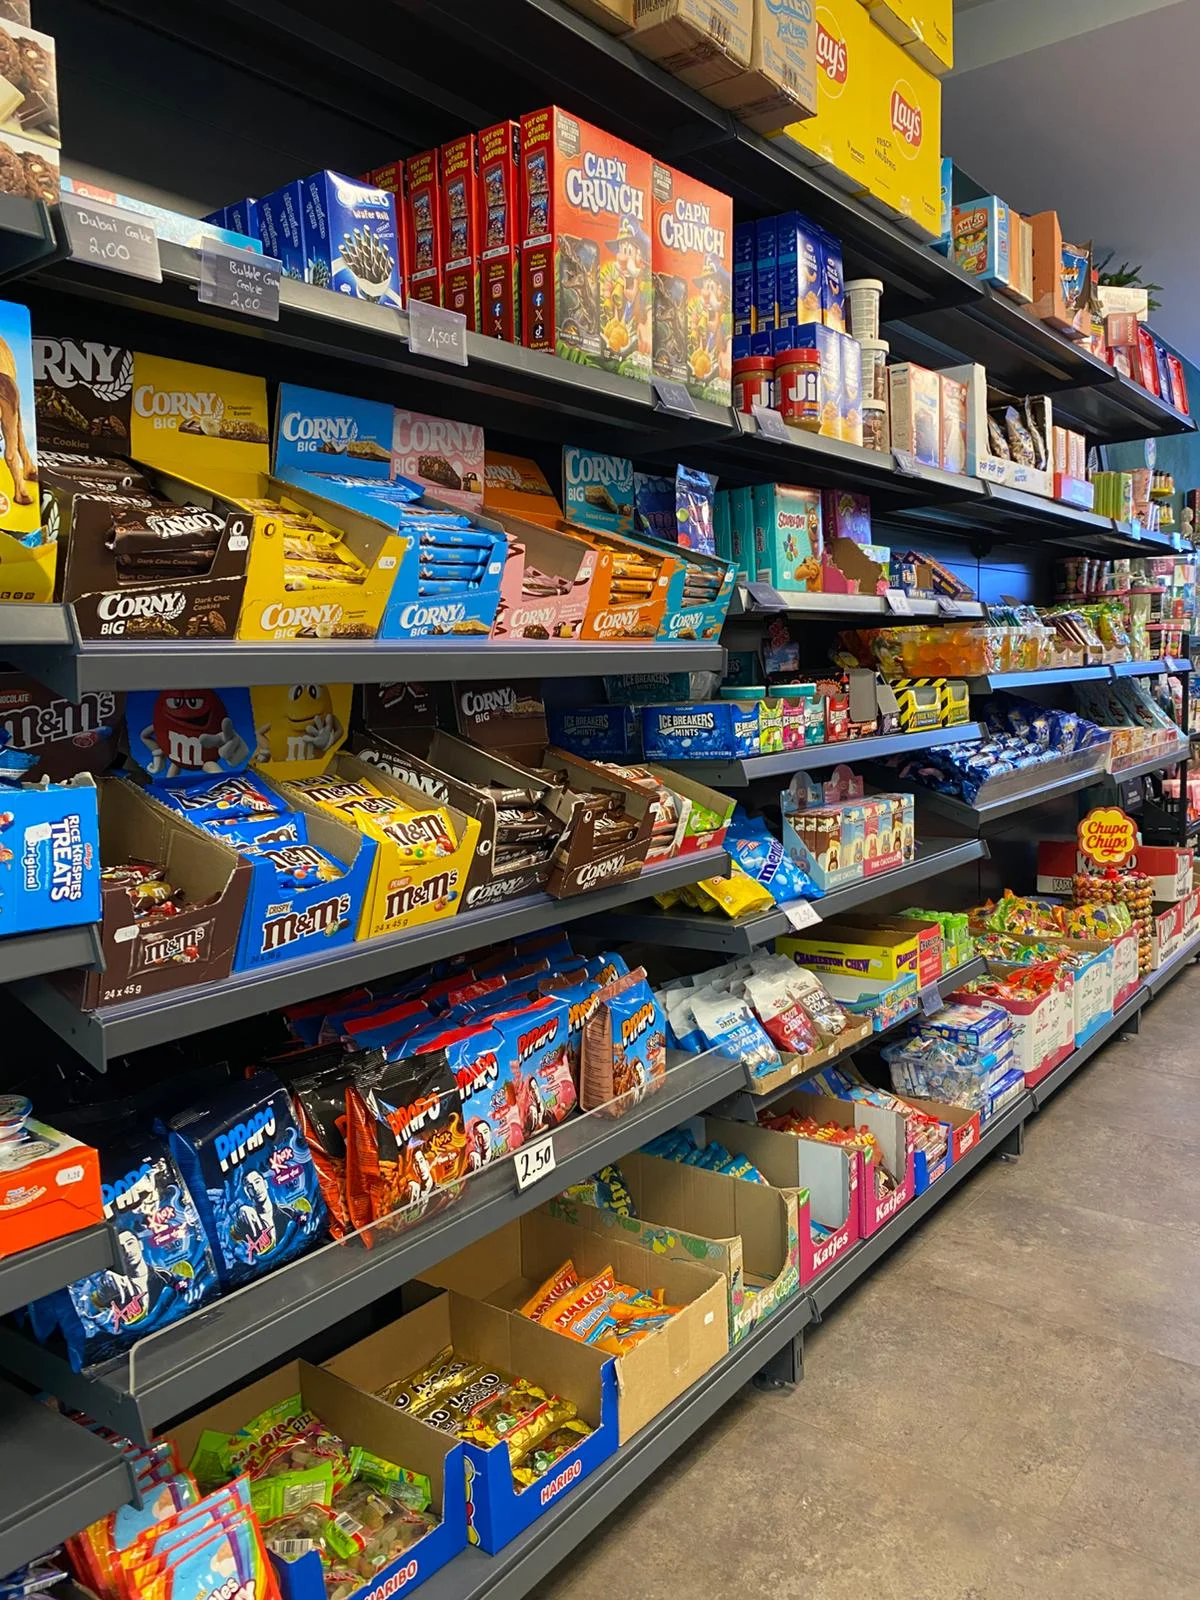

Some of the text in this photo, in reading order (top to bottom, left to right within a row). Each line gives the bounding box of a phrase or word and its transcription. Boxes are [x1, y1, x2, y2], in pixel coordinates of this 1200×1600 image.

[524, 112, 549, 130] TRY OUR
[527, 121, 545, 139] OTHER
[893, 92, 922, 144] Lay's
[523, 131, 551, 150] FLAVORS!
[583, 152, 627, 183] CAP'N
[566, 168, 645, 221] CRUNCH
[77, 210, 118, 232] Dubai
[675, 198, 710, 225] CAP'N
[660, 212, 726, 259] CRUNCH
[88, 236, 131, 261] 2,00
[230, 292, 261, 312] 2,00
[32, 337, 121, 389] RNY
[788, 372, 819, 402] Ji
[135, 384, 218, 419] CORNY
[153, 416, 177, 430] BIG
[282, 411, 353, 444] CORNY
[392, 411, 477, 457] CORNY
[297, 440, 317, 453] BIG
[393, 456, 417, 477] BIG
[564, 449, 628, 488] CORNY
[568, 486, 585, 503] BIG
[98, 591, 181, 621] CORNY
[260, 602, 340, 632] CORNY
[399, 603, 464, 630] CORNY
[510, 606, 555, 629] CORNY
[100, 620, 127, 636] BIG
[273, 627, 296, 640] BIG
[409, 625, 429, 638] BIG
[592, 610, 638, 633] CORNY
[668, 611, 703, 631] CORNY
[460, 685, 515, 718] CORNY
[475, 711, 490, 724] BIG
[575, 714, 610, 730] BREAKERS
[659, 712, 715, 730] ICE BREAKERS
[674, 728, 700, 738] MINTS
[168, 730, 204, 766] m
[1087, 821, 1129, 838] Chupa
[1086, 834, 1128, 851] Chups
[51, 818, 72, 900] TREATS
[68, 815, 84, 900] RICE KRISPIES
[576, 854, 626, 886] CORNY
[384, 869, 459, 921] m&m's
[465, 875, 525, 906] CORNY
[582, 878, 597, 890] BIG
[268, 902, 292, 916] CRISPY
[262, 895, 350, 953] m&m's
[374, 923, 386, 934] 24
[391, 920, 402, 930] 45
[144, 926, 206, 965] m&m's
[845, 957, 873, 974] CHEW
[104, 988, 116, 1001] 24
[124, 984, 135, 996] 45
[802, 989, 826, 1007] SOUR
[809, 999, 831, 1014] COLA
[215, 1106, 277, 1173] PIPAPO
[520, 1147, 552, 1181] 2.50
[875, 1186, 908, 1223] Katjes
[812, 1230, 849, 1270] Katjes
[540, 1459, 583, 1506] HARIBO
